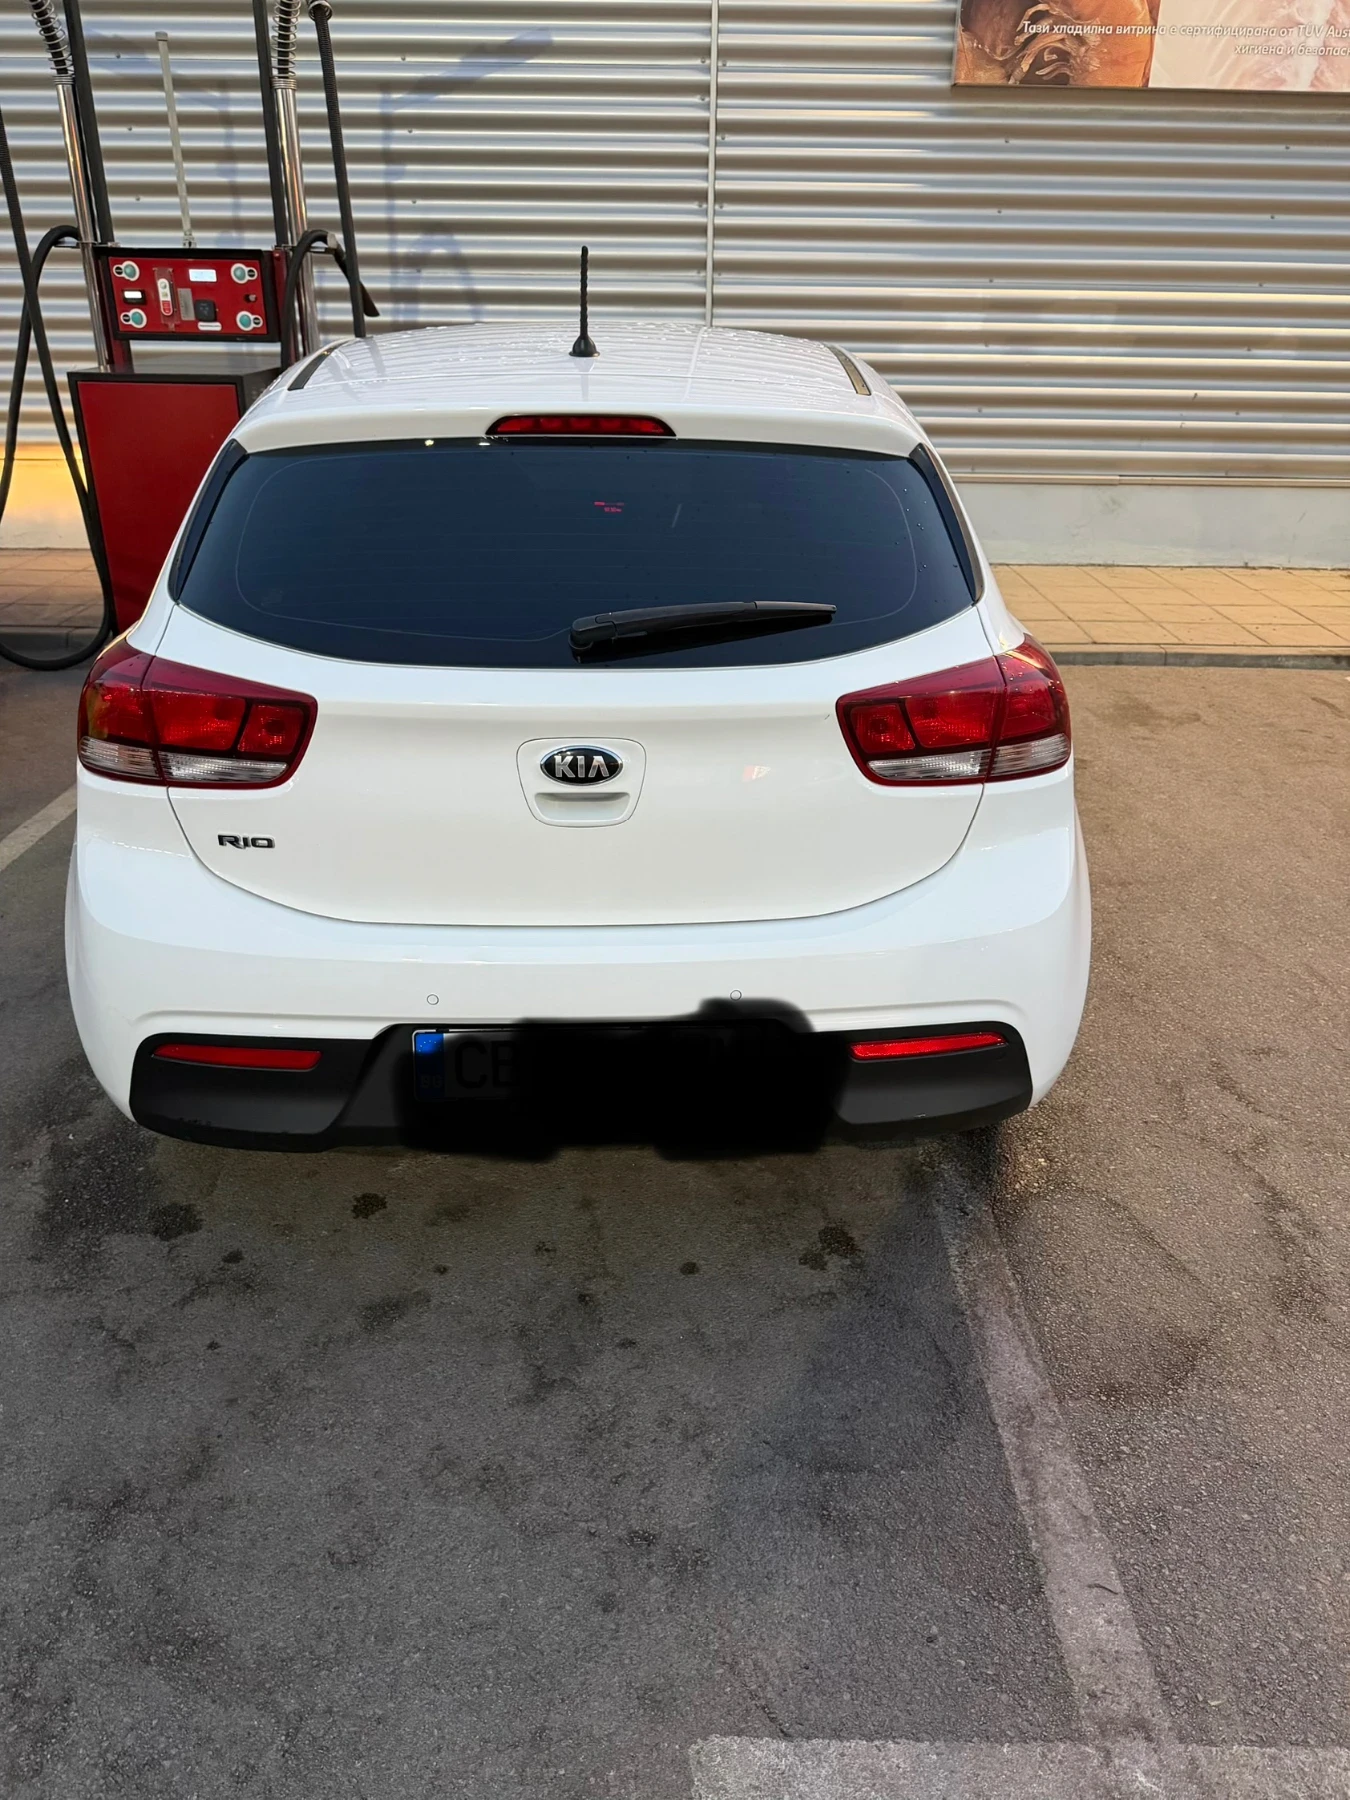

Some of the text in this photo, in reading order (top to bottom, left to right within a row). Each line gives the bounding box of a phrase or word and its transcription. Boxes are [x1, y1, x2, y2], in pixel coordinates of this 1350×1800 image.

[1023, 21, 1050, 33] Тази
[1053, 24, 1113, 35] хладилна
[1116, 26, 1167, 37] витрина
[1170, 26, 1177, 34] е
[1180, 23, 1277, 38] сертифицирана
[1280, 27, 1294, 36] от
[1298, 22, 1324, 37] TÜV
[1235, 45, 1284, 55] хигиена
[1286, 46, 1295, 55] и
[554, 755, 610, 778] KIA
[217, 833, 276, 850] RIO
